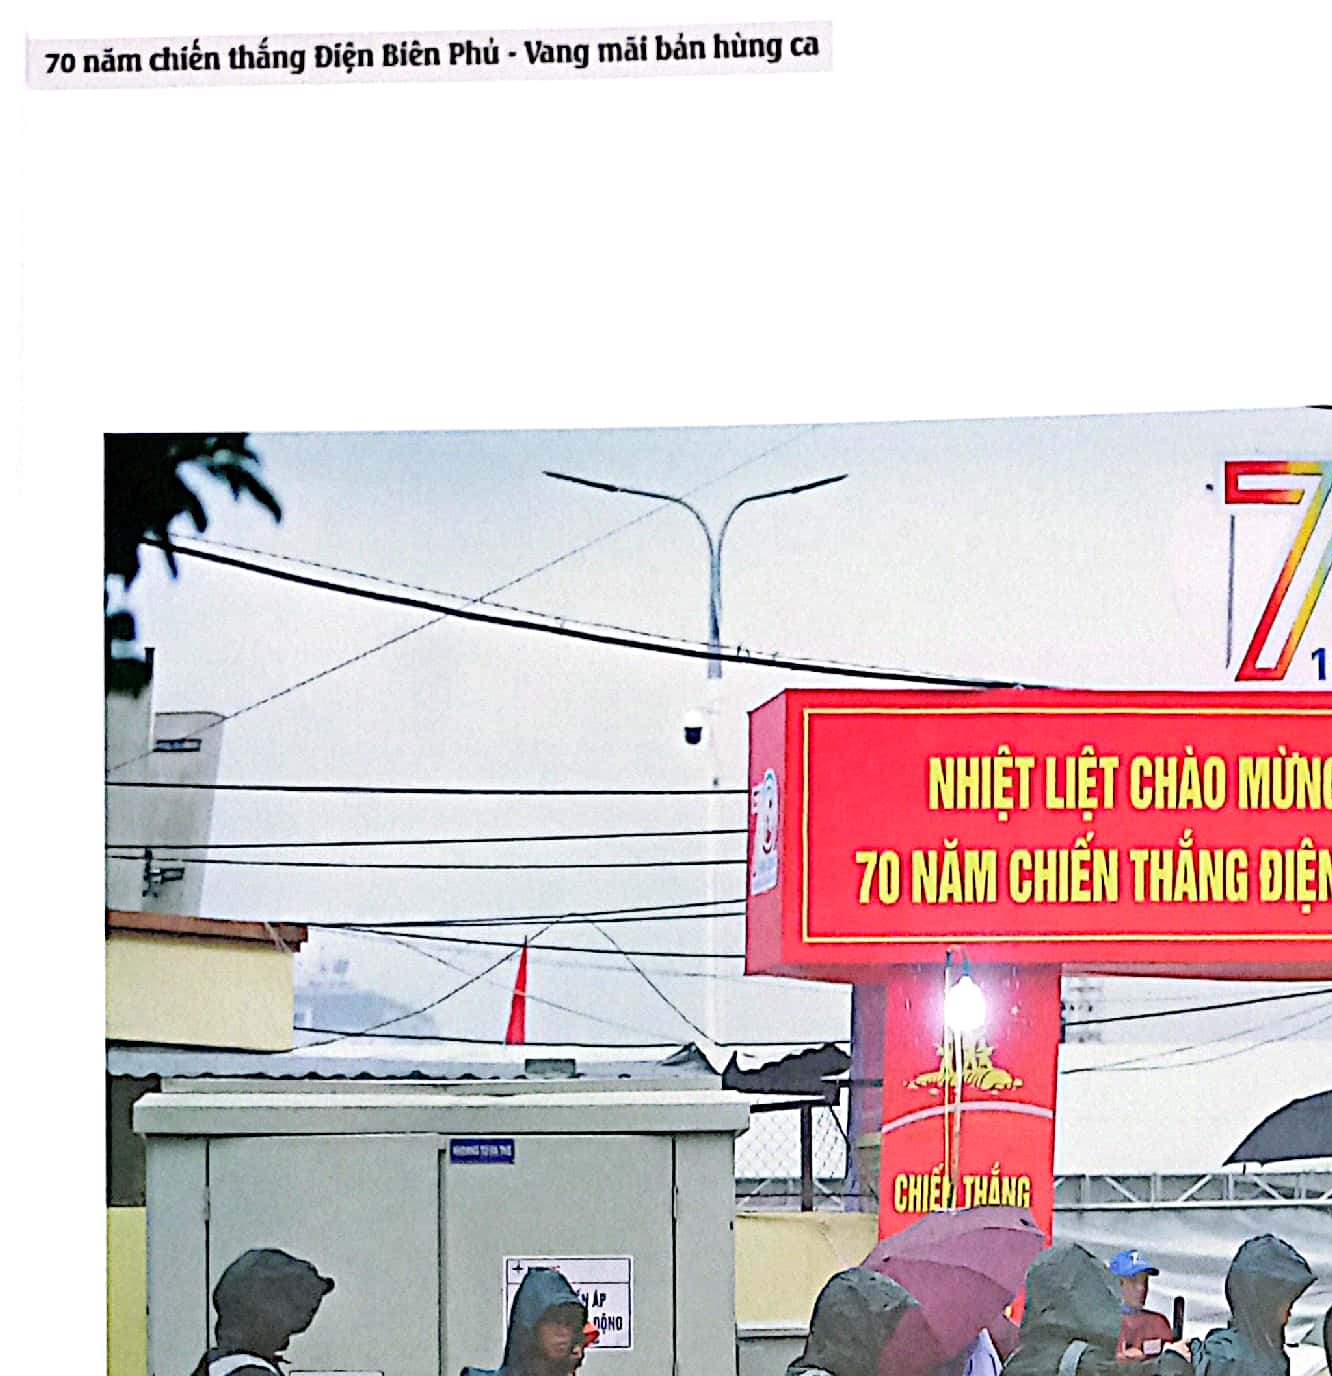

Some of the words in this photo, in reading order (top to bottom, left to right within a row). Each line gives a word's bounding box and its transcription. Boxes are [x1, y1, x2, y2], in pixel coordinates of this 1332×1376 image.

[44, 53, 76, 74] 70
[83, 47, 143, 73] năm
[149, 38, 221, 72] chiến
[228, 37, 306, 75] thắng
[314, 41, 374, 75] Điện
[382, 39, 441, 67] Biên
[448, 37, 500, 66] Phủ
[523, 40, 590, 69] Vang
[597, 35, 648, 63] mãi
[654, 32, 707, 61] bản
[713, 31, 783, 64] hùng
[790, 36, 820, 57] ca
[929, 745, 1035, 821] NHIỆT
[1045, 745, 1120, 821] LIỆT
[1130, 745, 1226, 810] CHÀO
[855, 850, 900, 904] 70
[911, 838, 997, 904] NĂM
[1009, 830, 1118, 903] CHIẾN
[1129, 828, 1248, 902] THẮNG
[963, 1161, 1031, 1209] THẮNG
